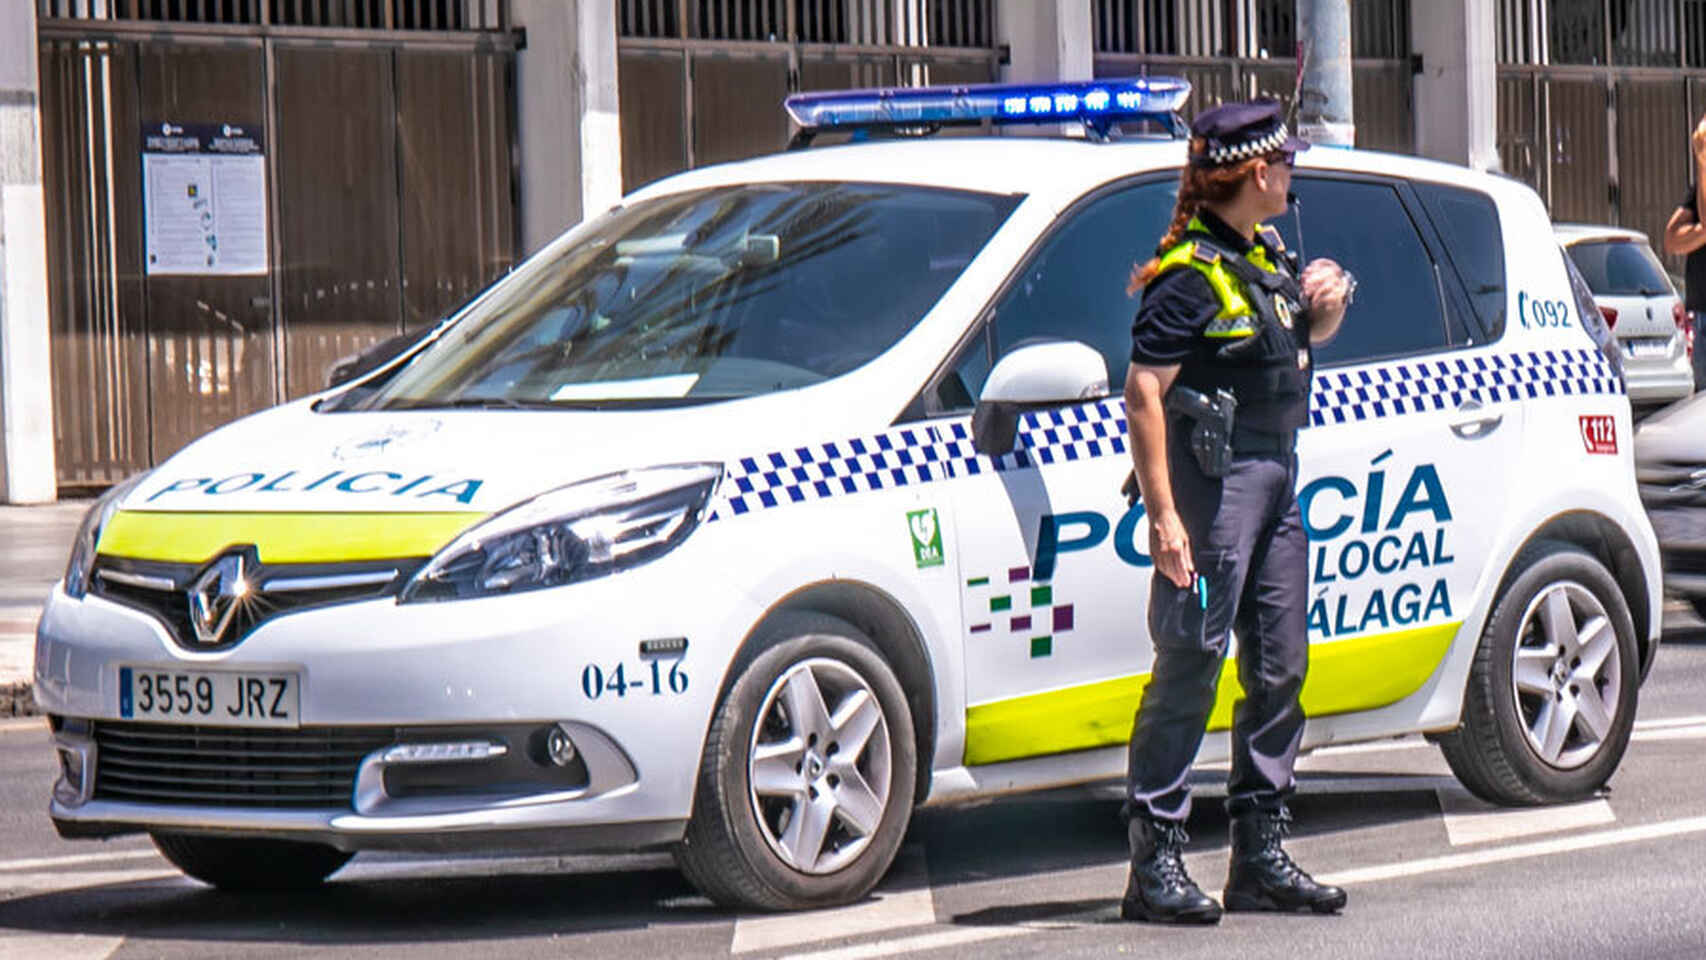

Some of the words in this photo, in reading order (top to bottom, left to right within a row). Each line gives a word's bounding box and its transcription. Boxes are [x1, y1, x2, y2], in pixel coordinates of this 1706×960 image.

[1532, 299, 1573, 327] 092
[1591, 418, 1613, 442] 112
[146, 470, 484, 504] POLICIA
[1033, 448, 1453, 582] POCÍA
[1314, 528, 1455, 584] LOCAL
[1307, 577, 1453, 638] ÁLAGA
[138, 674, 213, 715] 3559
[227, 676, 288, 718] JRZ
[582, 659, 689, 700] 04-16
